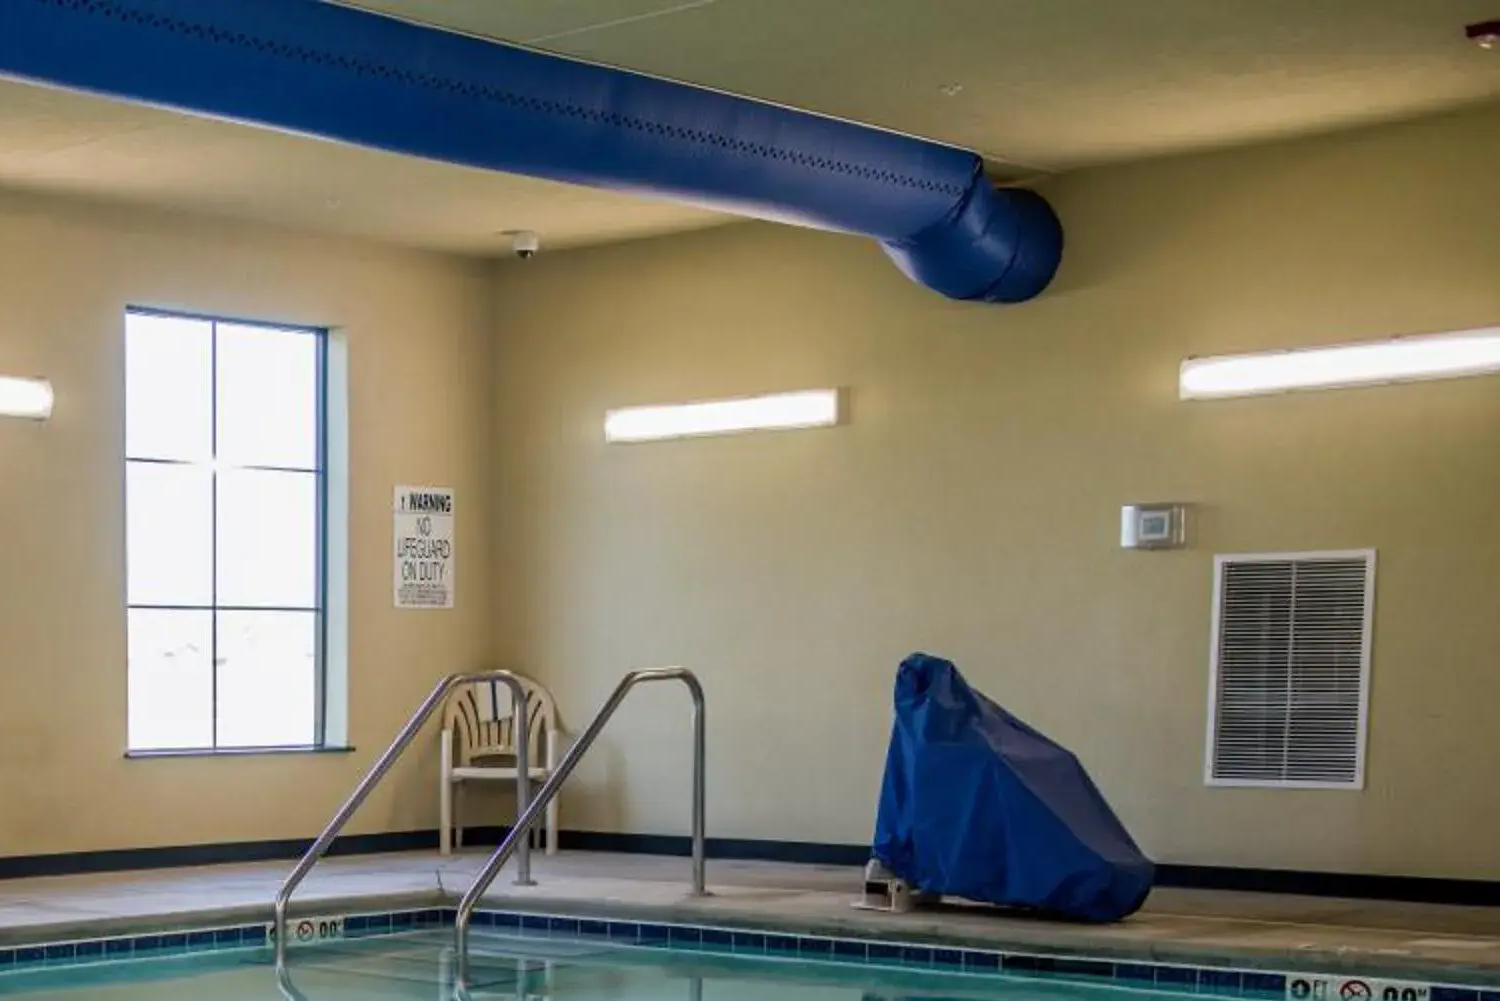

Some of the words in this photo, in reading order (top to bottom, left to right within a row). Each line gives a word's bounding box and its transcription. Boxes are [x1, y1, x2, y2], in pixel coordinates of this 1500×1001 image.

[409, 492, 451, 513] WARNING
[416, 516, 432, 537] NO
[397, 537, 451, 559] LIFEGUARD
[401, 560, 417, 581] ON
[419, 561, 445, 581] DUTY
